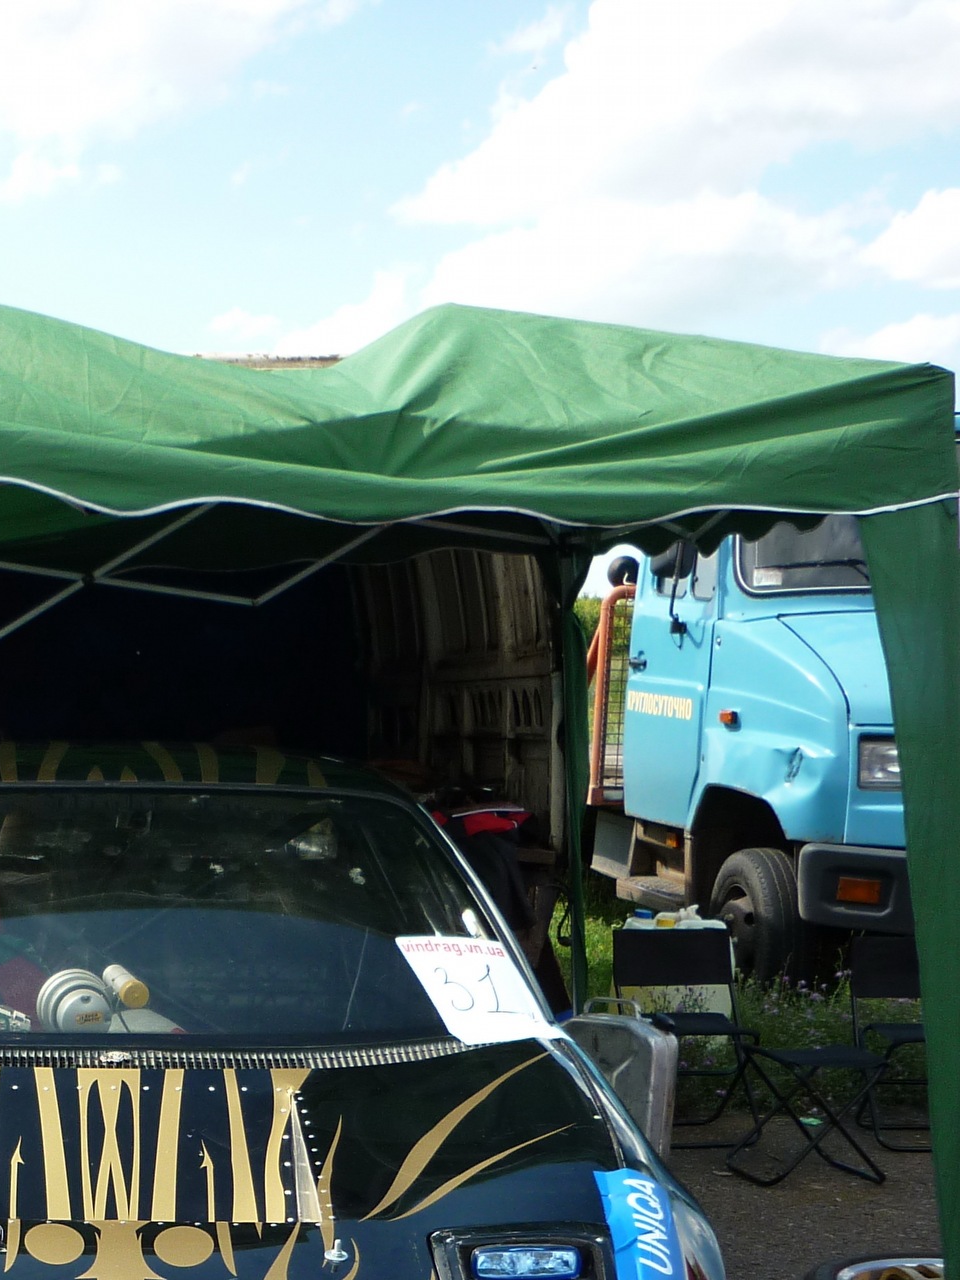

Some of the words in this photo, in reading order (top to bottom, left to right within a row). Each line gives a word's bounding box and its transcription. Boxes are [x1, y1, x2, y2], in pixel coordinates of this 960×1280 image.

[401, 940, 506, 958] vindrag.vn.ua
[434, 964, 524, 1013] 31
[623, 1178, 673, 1276] UNIQA
